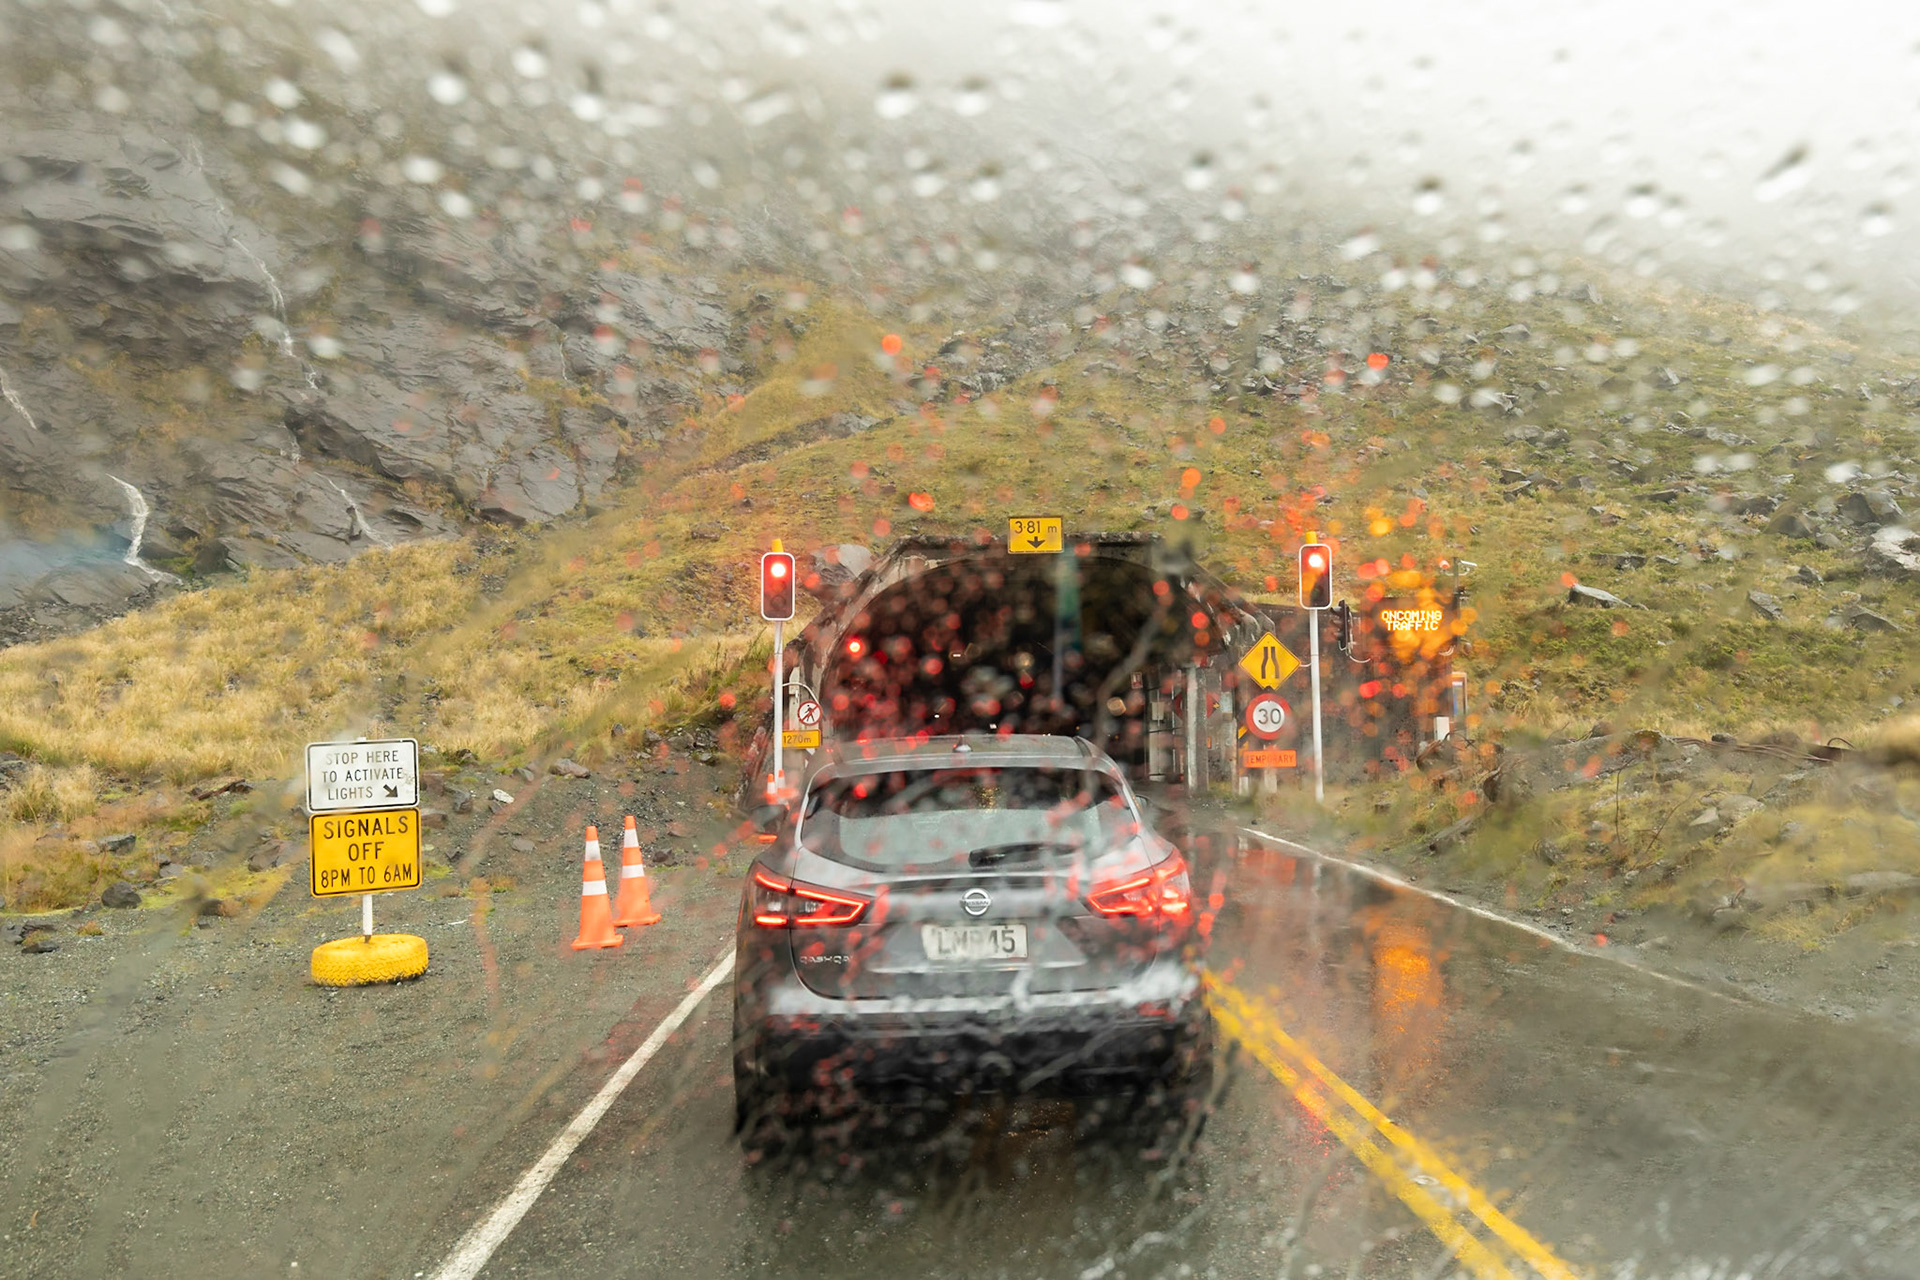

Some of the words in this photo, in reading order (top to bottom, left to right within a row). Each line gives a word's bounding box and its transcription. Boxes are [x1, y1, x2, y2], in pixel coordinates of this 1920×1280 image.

[1047, 525, 1058, 533] m
[1381, 610, 1442, 621] ONCOMING
[1385, 620, 1439, 631] TRAFFIC
[1258, 708, 1282, 725] 30
[326, 752, 358, 766] STOP
[366, 750, 399, 763] HERE
[321, 770, 338, 783] TO
[345, 767, 403, 782] ACTIVATE
[327, 786, 373, 801] LIGHTS
[323, 815, 408, 839] SIGNALS
[348, 841, 385, 862] OFF
[321, 867, 351, 888] 8PM
[359, 866, 376, 885] TO
[383, 863, 412, 883] 6AM
